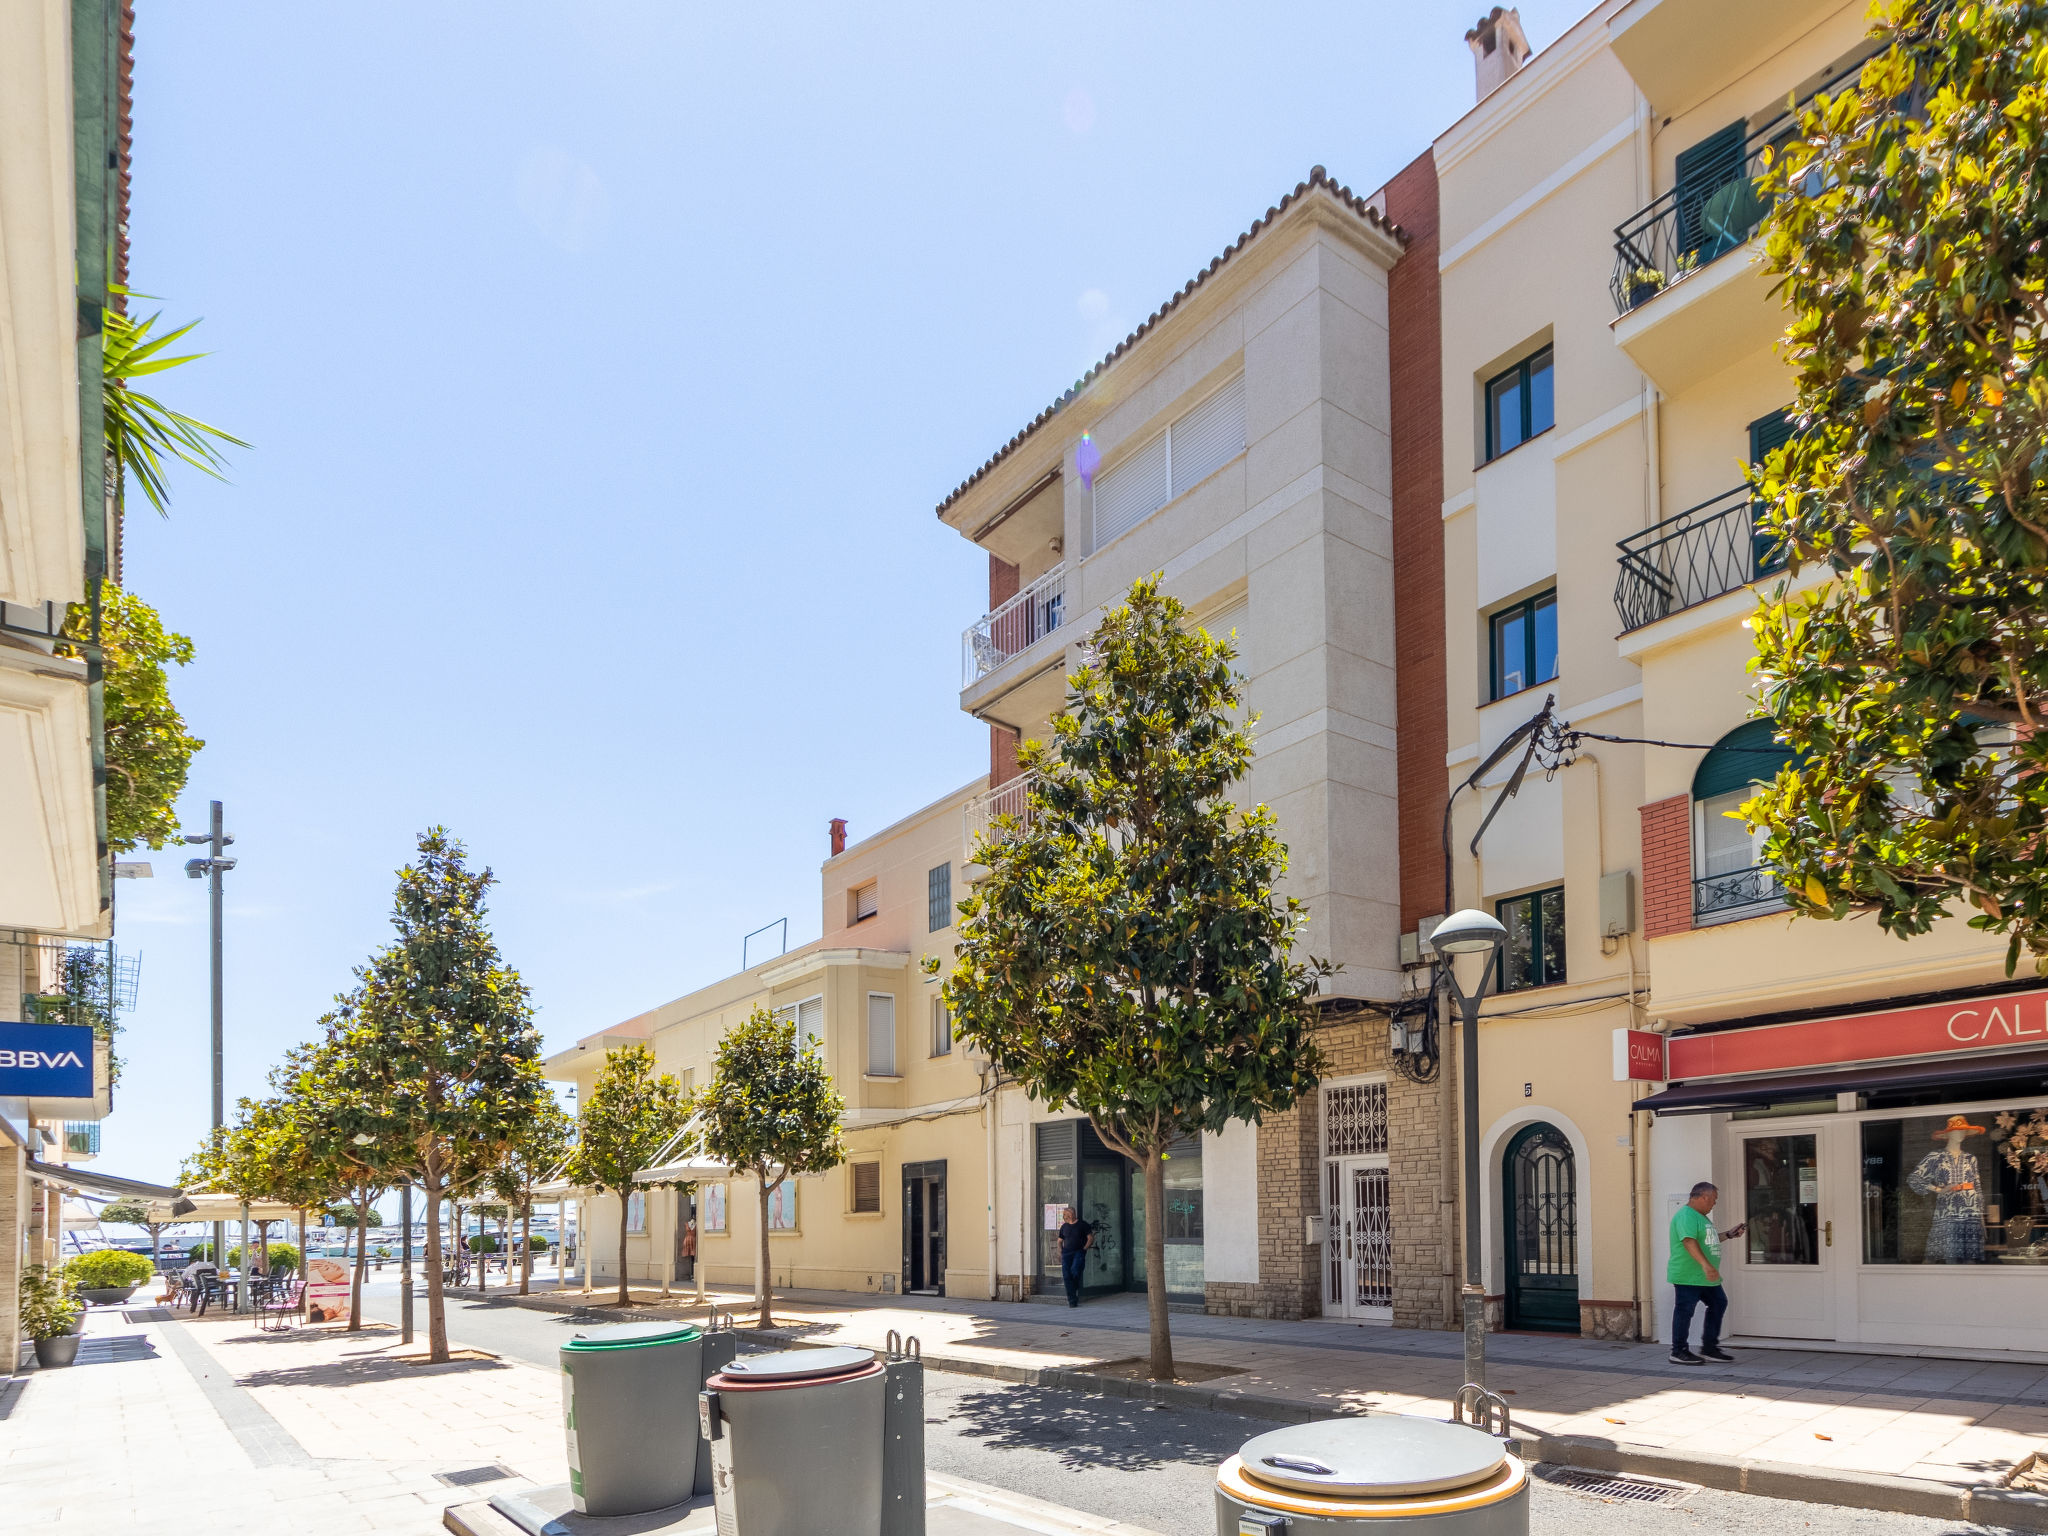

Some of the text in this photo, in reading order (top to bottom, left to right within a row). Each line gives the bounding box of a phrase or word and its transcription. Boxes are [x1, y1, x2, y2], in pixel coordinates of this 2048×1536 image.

[1947, 999, 2048, 1041] CAL
[0, 1050, 84, 1069] BBVA
[1630, 1044, 1660, 1062] CALMA
[1525, 1084, 1531, 1095] 5
